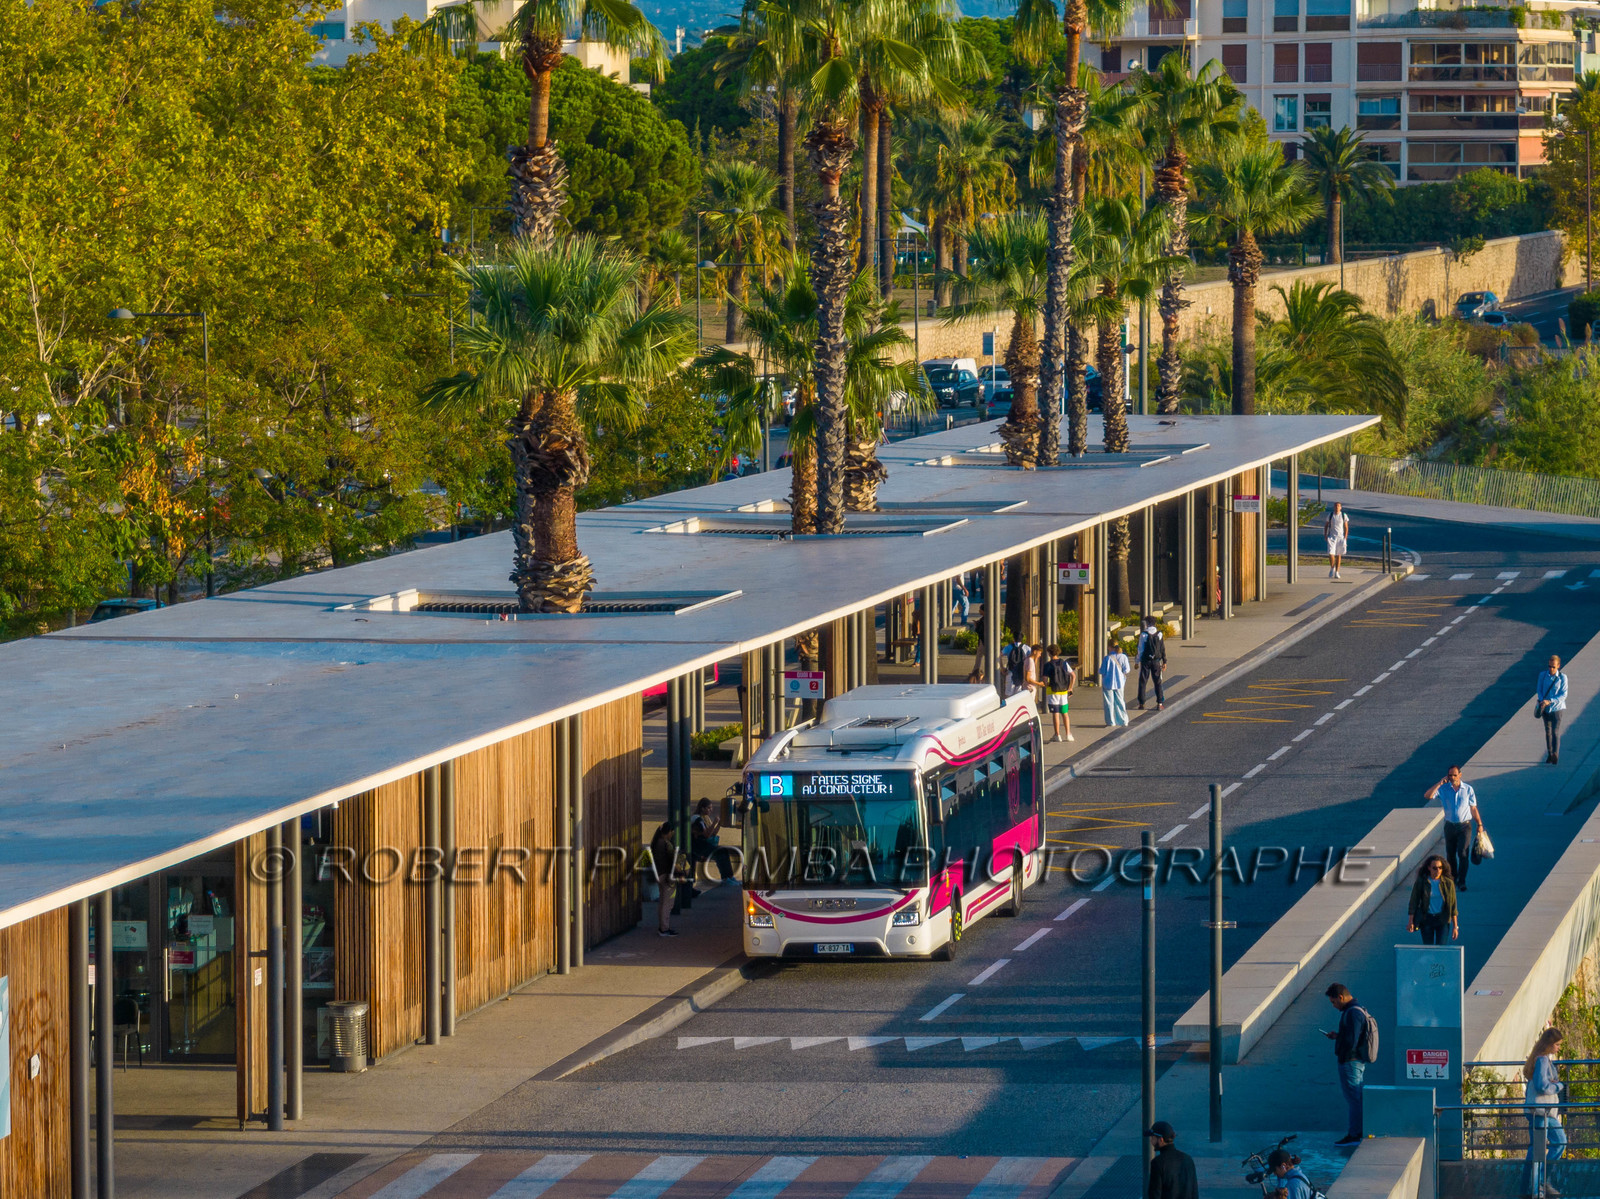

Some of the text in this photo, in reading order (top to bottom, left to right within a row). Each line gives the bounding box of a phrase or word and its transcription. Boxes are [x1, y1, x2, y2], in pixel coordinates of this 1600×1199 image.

[811, 774, 883, 785] FAITES SIGNE
[769, 775, 784, 796] B
[802, 784, 817, 795] AU
[819, 784, 887, 795] CONDUCTEUR
